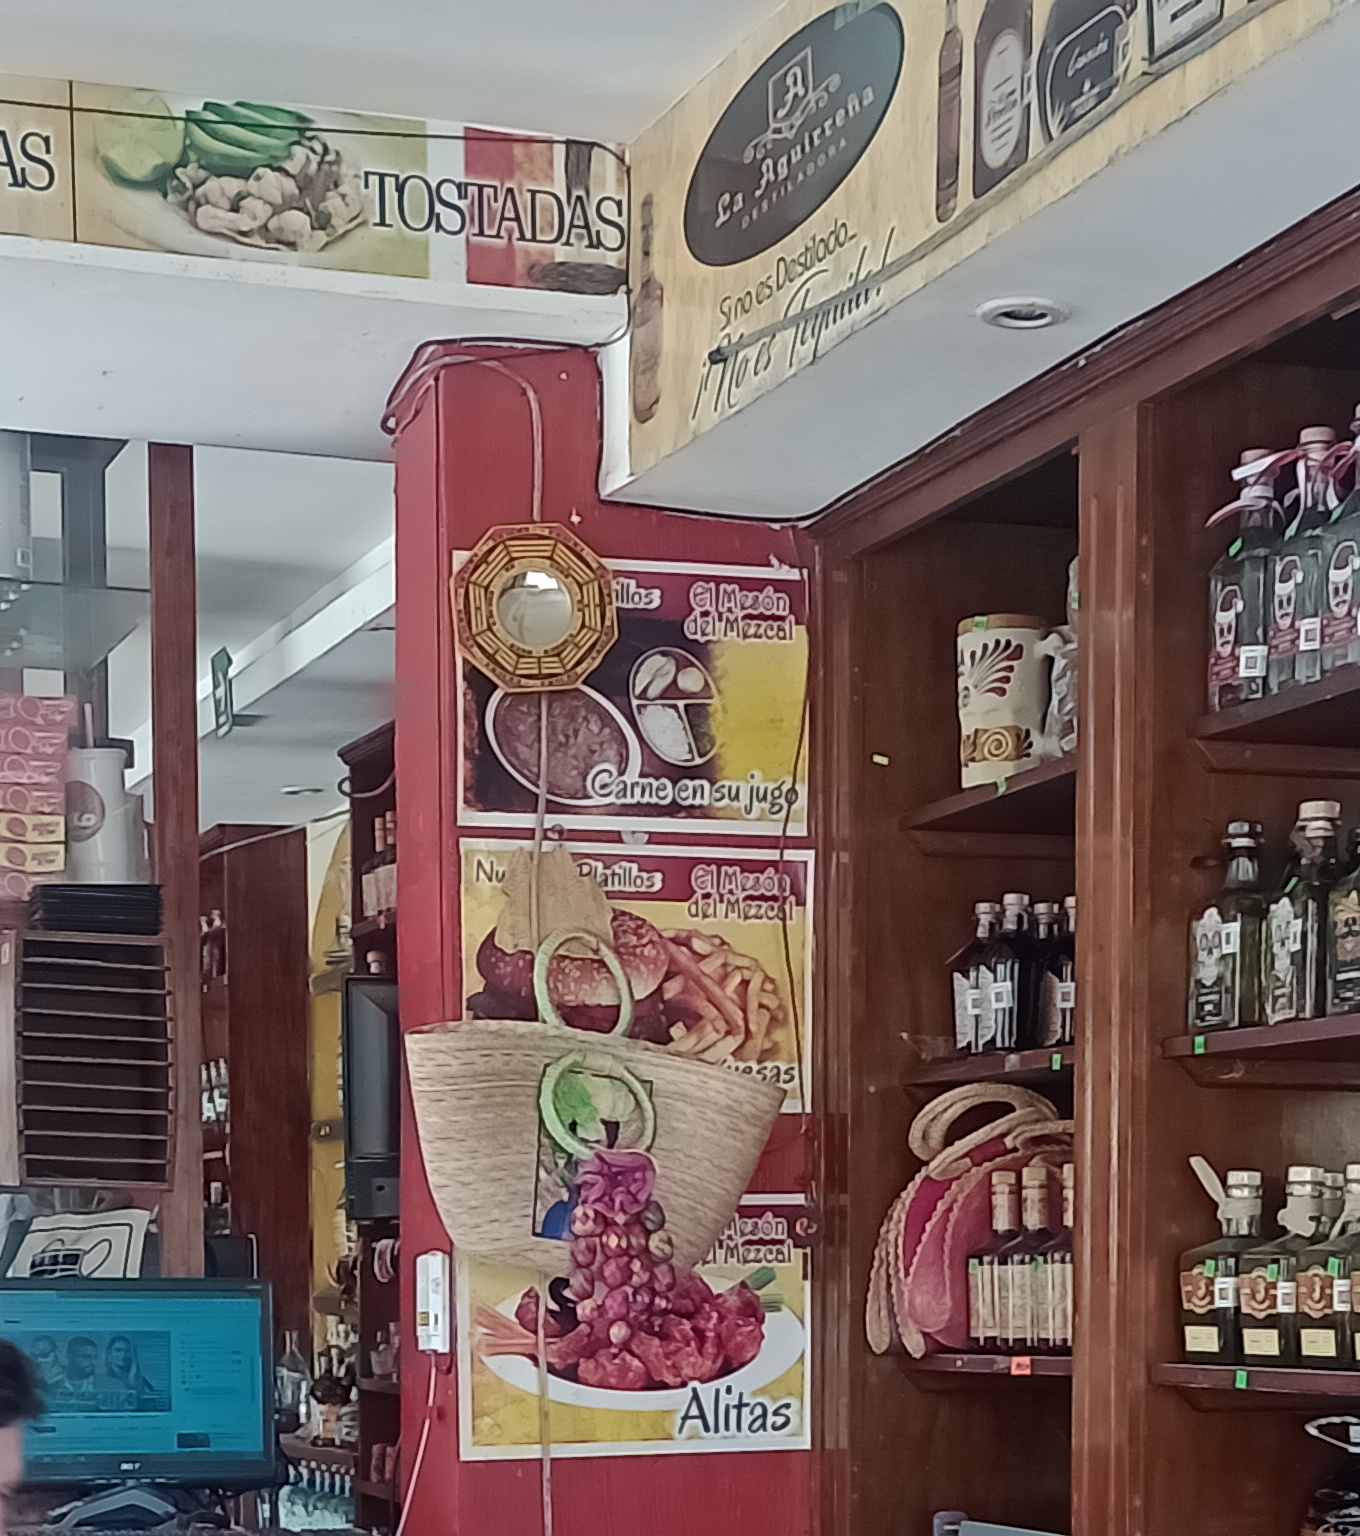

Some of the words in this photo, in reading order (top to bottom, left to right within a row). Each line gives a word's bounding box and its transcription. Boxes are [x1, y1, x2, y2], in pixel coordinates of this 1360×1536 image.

[362, 169, 626, 252] TOSTADAS
[714, 191, 745, 229] La
[691, 582, 716, 608] El
[719, 586, 790, 613] Mesón
[684, 612, 717, 640] del
[722, 614, 794, 641] Mezcal
[589, 767, 668, 802] Carne
[677, 782, 706, 802] en
[712, 783, 741, 803] su
[691, 867, 716, 891] El
[719, 867, 791, 894] Mesón
[687, 898, 719, 920] del
[723, 899, 795, 921] Mezcal
[723, 1243, 792, 1265] Mezcal
[677, 1384, 793, 1435] Alitas
